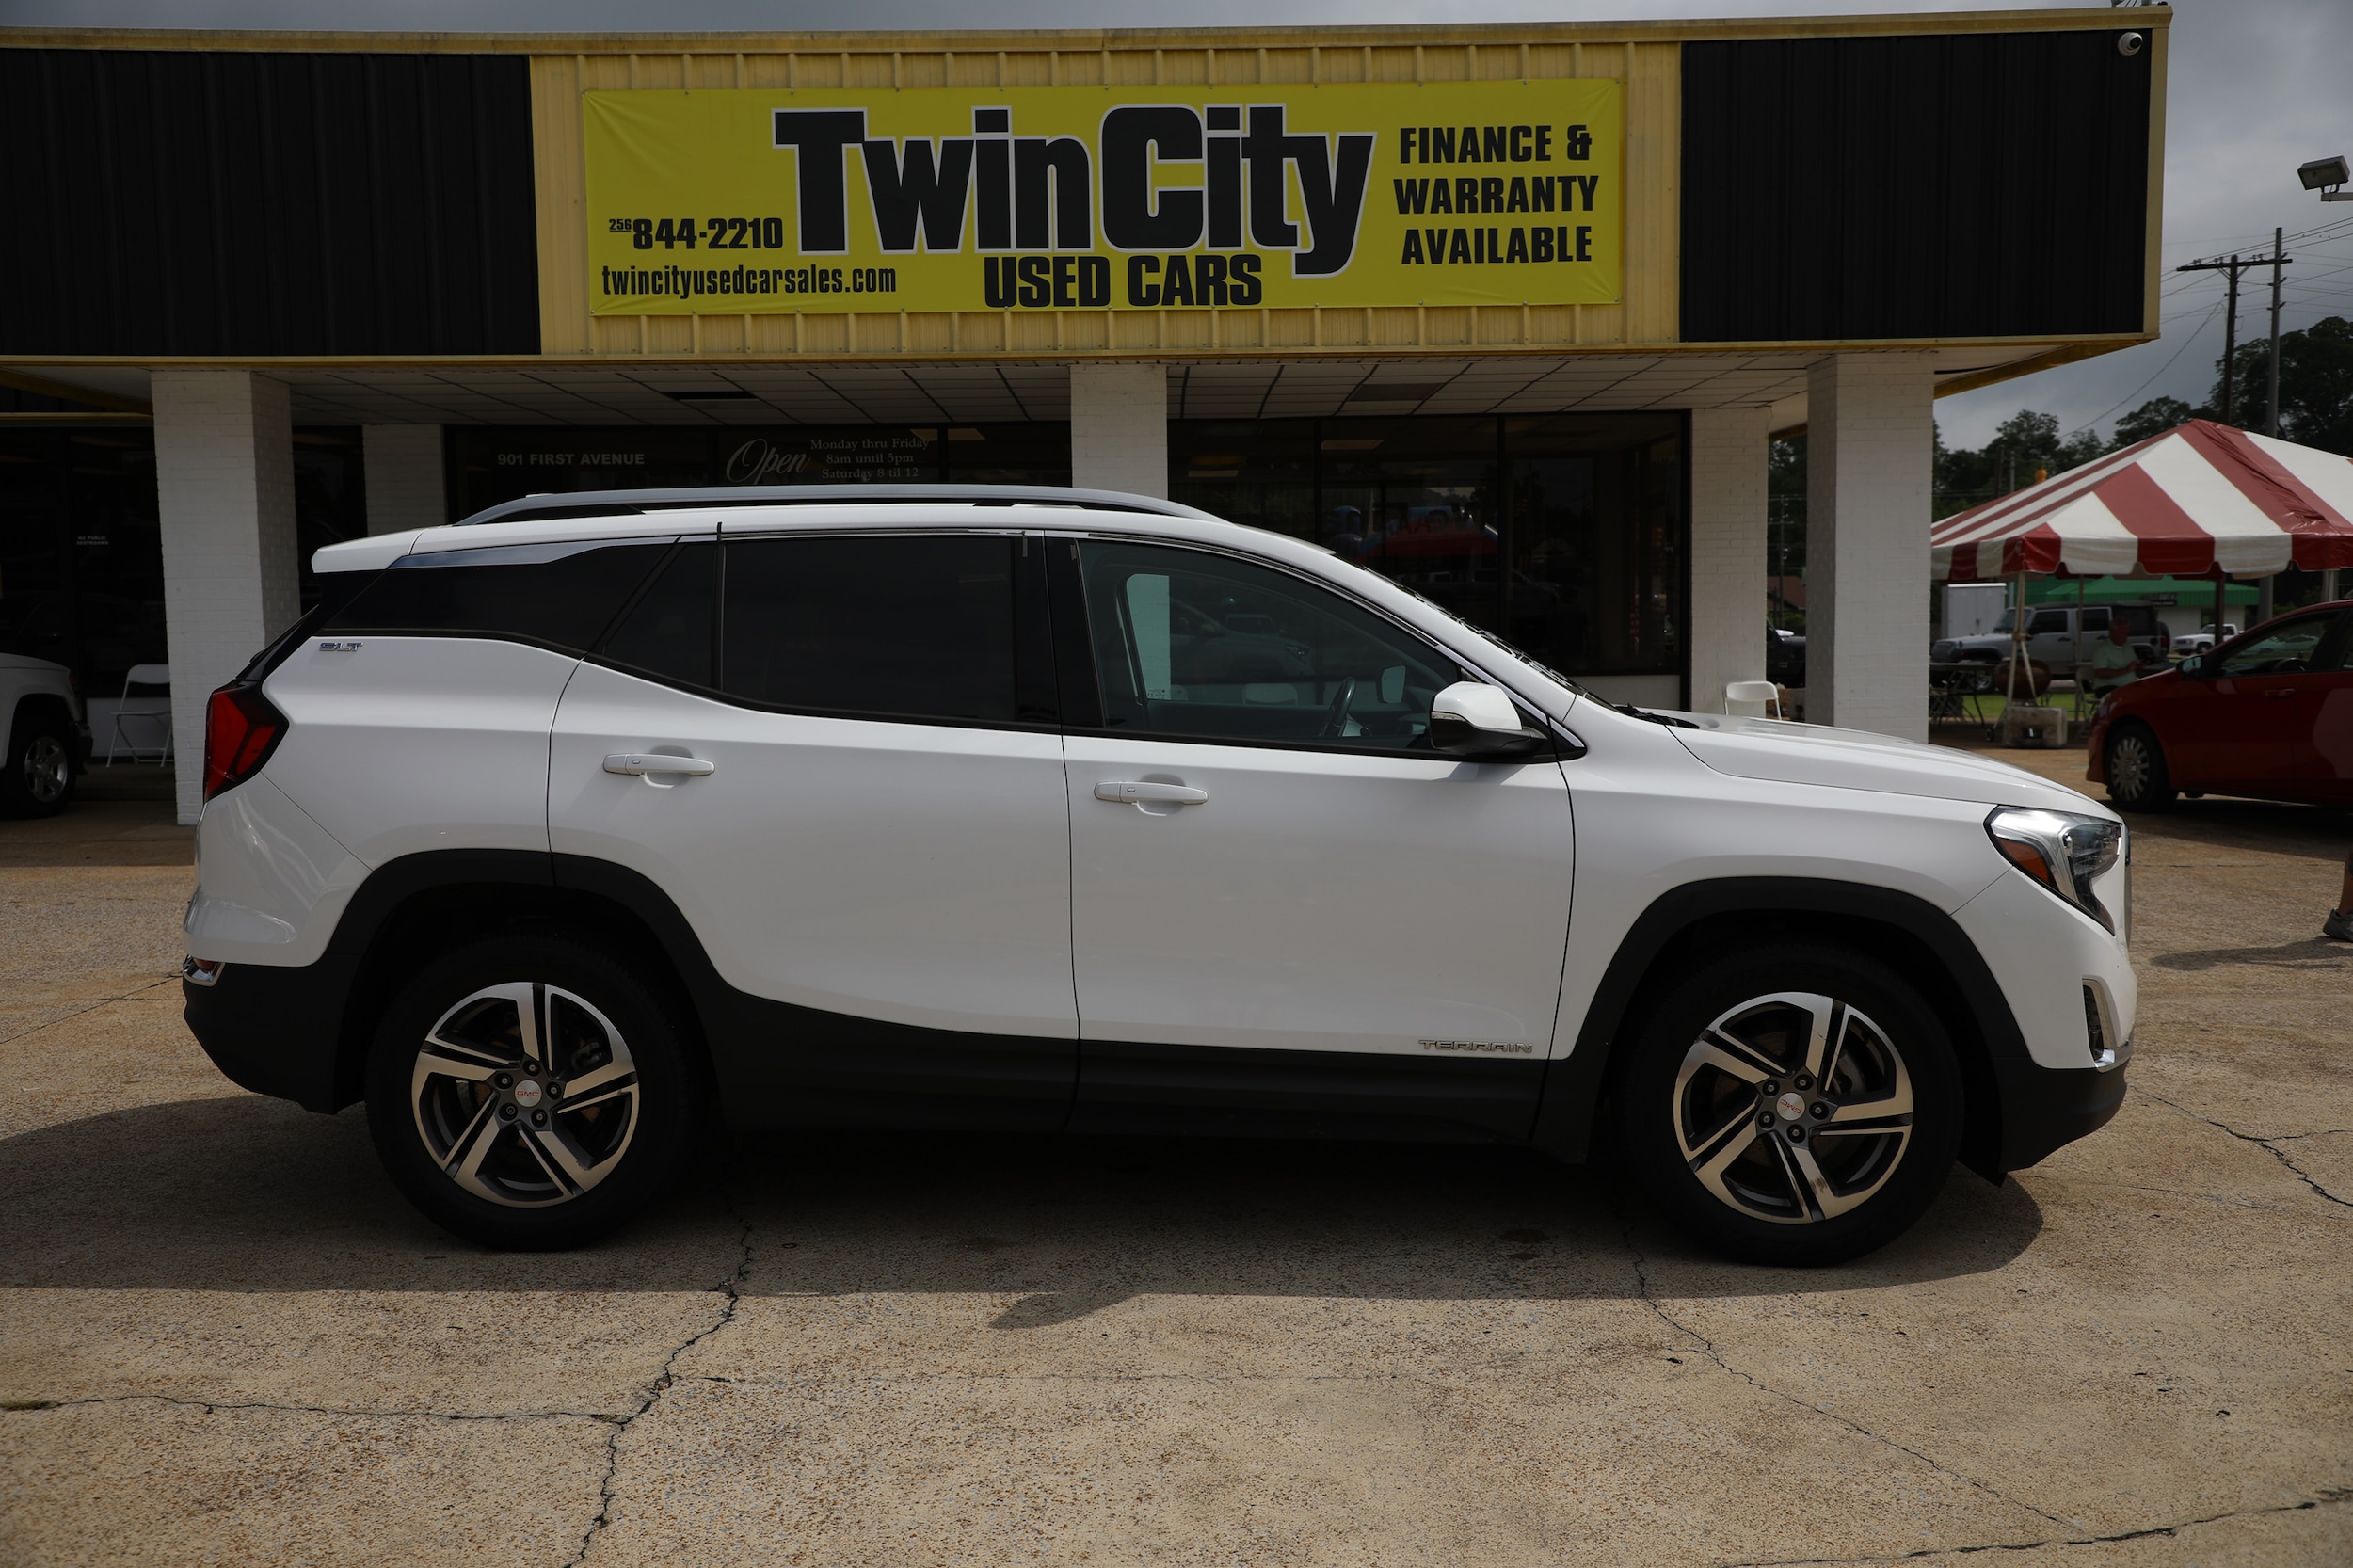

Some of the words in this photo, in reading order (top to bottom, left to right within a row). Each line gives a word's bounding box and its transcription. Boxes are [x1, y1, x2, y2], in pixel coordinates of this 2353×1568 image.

[1399, 124, 1552, 164] FINANCE
[1567, 124, 1593, 161] &
[1393, 175, 1599, 215] WARRANTY
[609, 217, 632, 233] 256
[632, 217, 783, 250] 844-2210
[1401, 226, 1593, 264] AVAILABLE
[602, 264, 896, 299] twincityusedcarsales.com
[984, 255, 1112, 308] USED
[1128, 254, 1262, 307] CARS
[809, 438, 858, 453] Monday
[862, 438, 888, 449] thru
[892, 437, 930, 451] Friday
[497, 453, 523, 465] 901
[529, 453, 575, 465] FIRST
[580, 453, 646, 465] AVENUE
[726, 438, 811, 485] Open
[825, 453, 852, 465] 8am
[856, 452, 884, 464] until
[888, 453, 914, 466] 5pm
[822, 468, 874, 481] Saturday
[876, 468, 885, 478] 8
[905, 467, 919, 478] 12
[320, 642, 364, 651] SLT
[1418, 1039, 1533, 1053] TERRAIN
[1780, 1098, 1801, 1114] GMC
